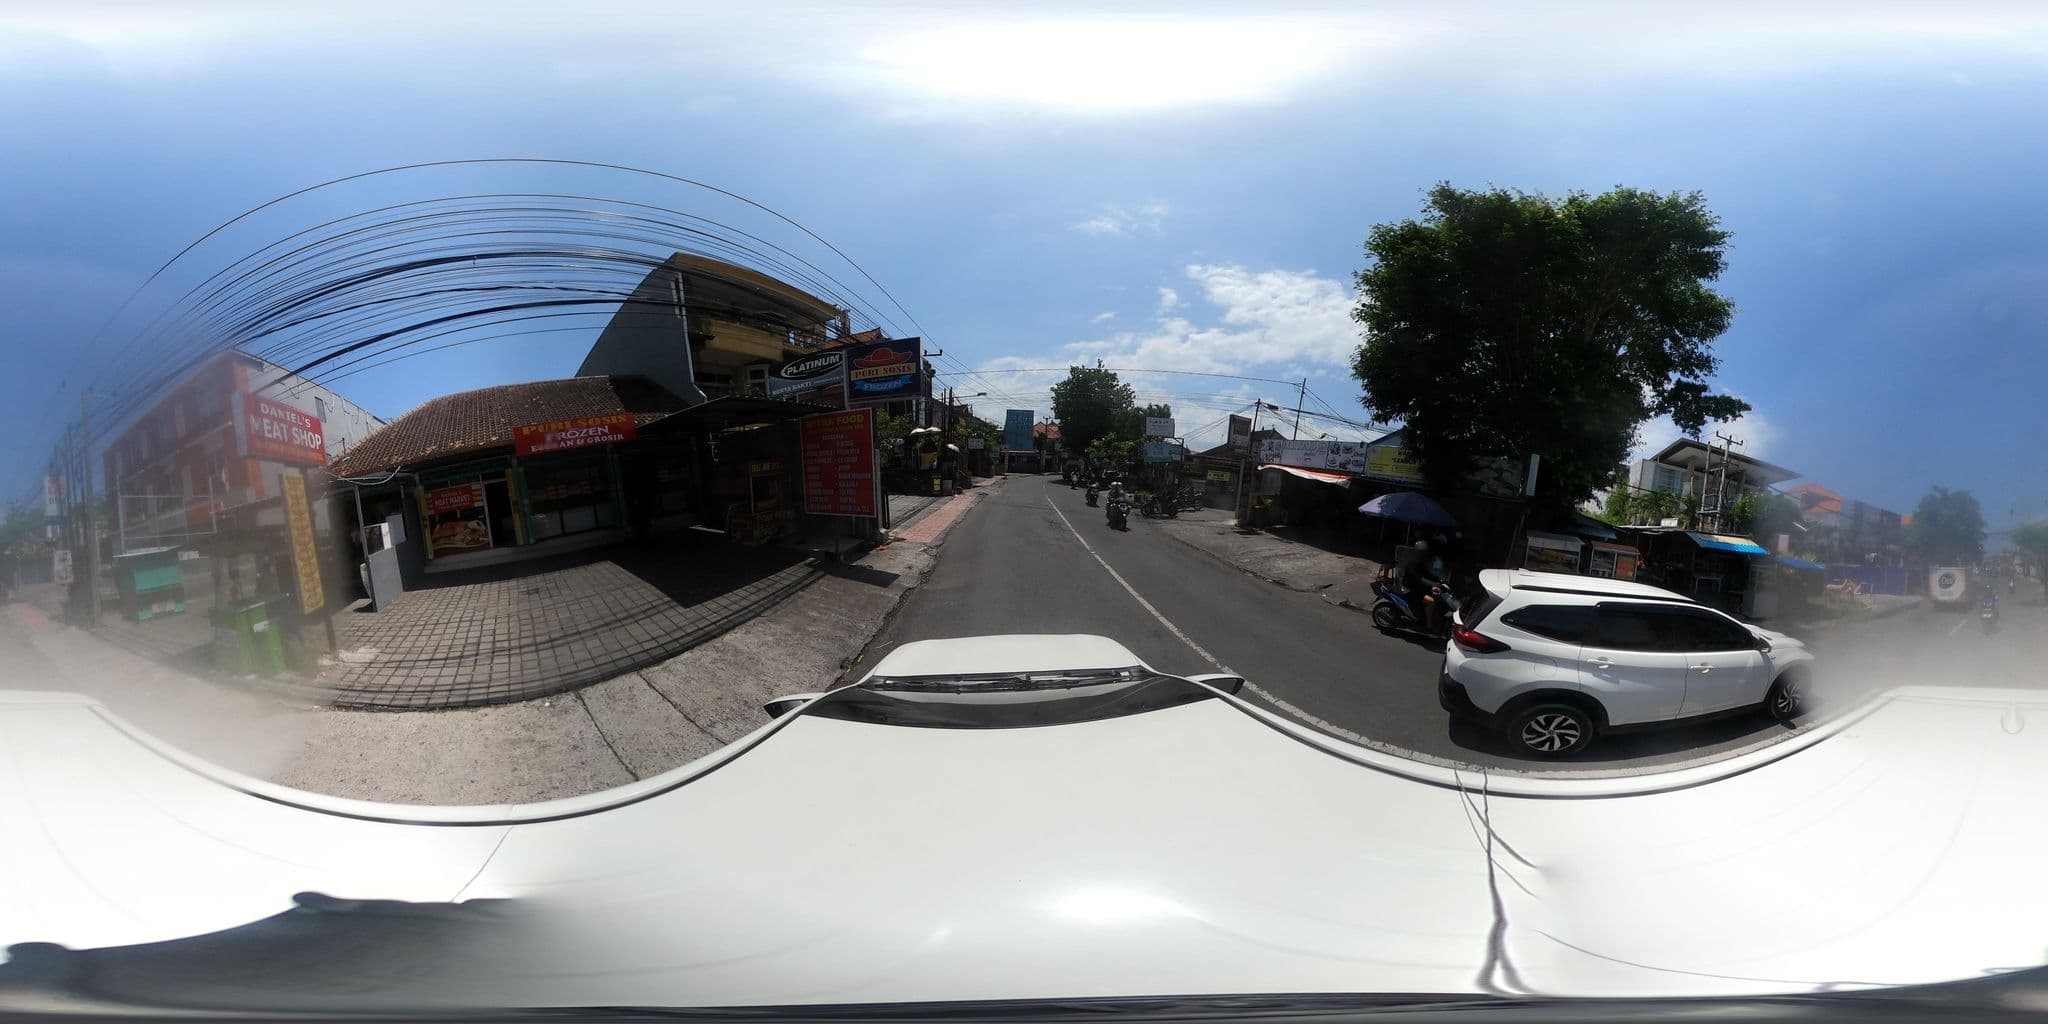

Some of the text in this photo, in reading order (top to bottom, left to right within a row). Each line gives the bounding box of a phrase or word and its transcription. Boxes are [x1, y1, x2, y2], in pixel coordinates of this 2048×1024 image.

[786, 353, 841, 376] PLATINUM
[855, 364, 913, 379] PURI SOSIS
[863, 378, 903, 391] FROZEN
[260, 403, 312, 428] DANIEL'S
[838, 413, 865, 425] FOOD
[250, 415, 322, 450] MEAT SHOP
[521, 414, 627, 436] PURI SOSIS
[586, 433, 625, 444] GROSIR
